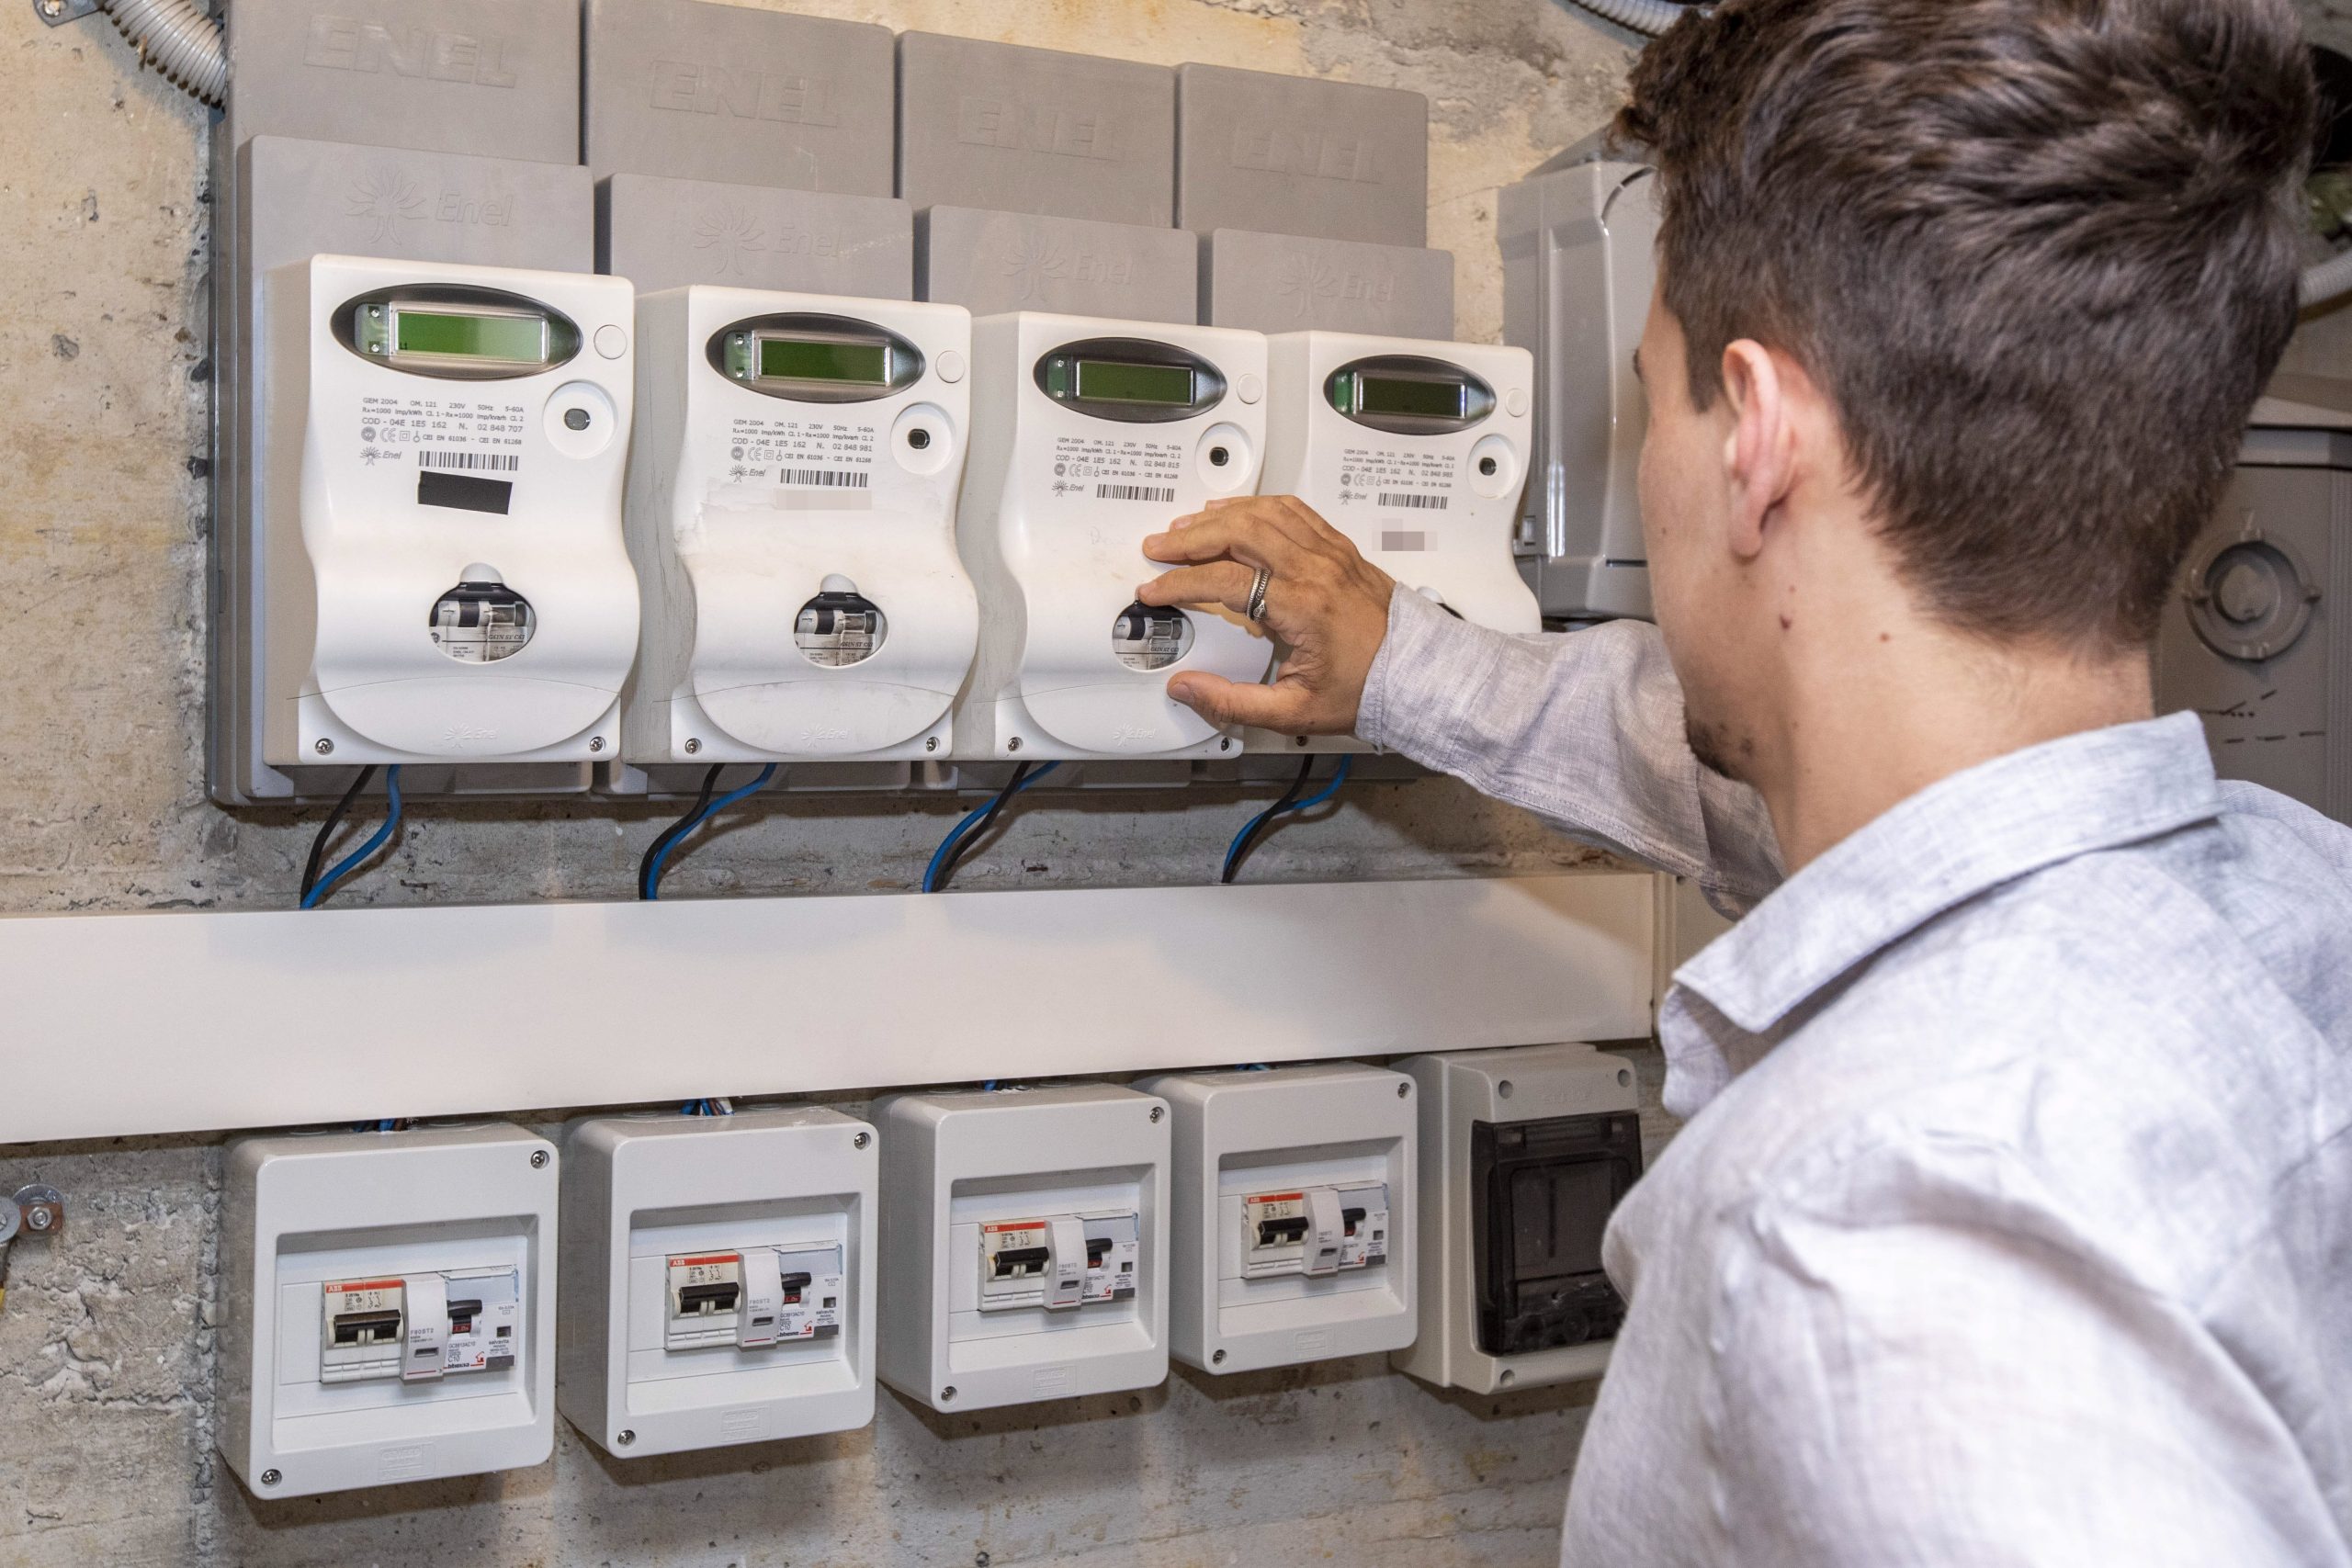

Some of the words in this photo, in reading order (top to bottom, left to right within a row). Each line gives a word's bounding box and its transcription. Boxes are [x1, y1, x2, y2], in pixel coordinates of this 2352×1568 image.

[302, 14, 517, 89] ENEL
[649, 59, 838, 129] ENEL
[958, 95, 1123, 162] ENEL
[435, 189, 514, 228] Enel
[773, 223, 842, 258] Enel
[1073, 251, 1136, 286] Enel
[382, 451, 402, 459] Enel
[749, 468, 766, 477] Enel
[447, 1354, 459, 1362] C10
